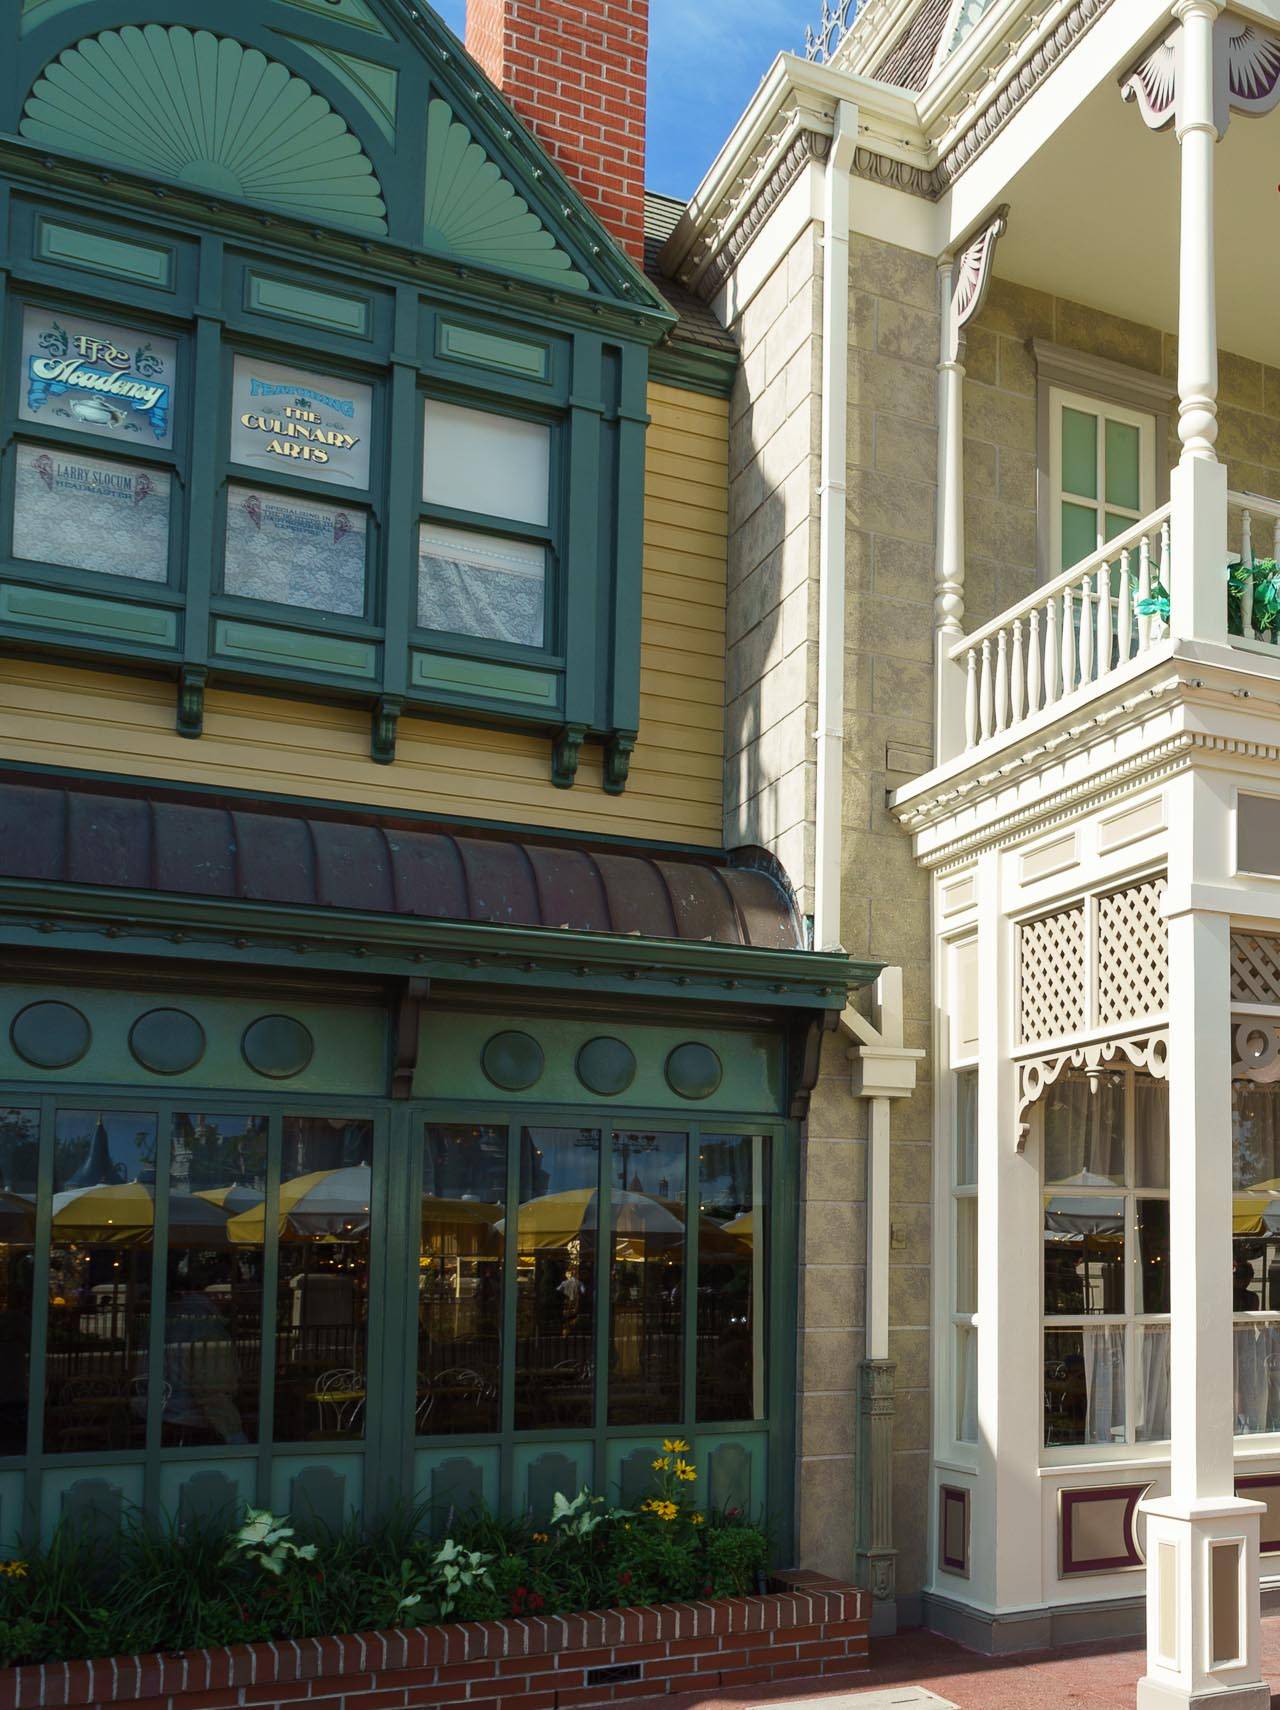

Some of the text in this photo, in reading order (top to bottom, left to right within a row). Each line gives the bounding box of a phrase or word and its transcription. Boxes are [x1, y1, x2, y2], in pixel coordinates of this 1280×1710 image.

[33, 358, 166, 410] Academy
[251, 378, 355, 418] FEATURING
[283, 406, 321, 424] THE
[240, 413, 360, 450] CULINARY
[265, 439, 329, 464] ARTS
[57, 463, 132, 491] LARRY SLOCUM
